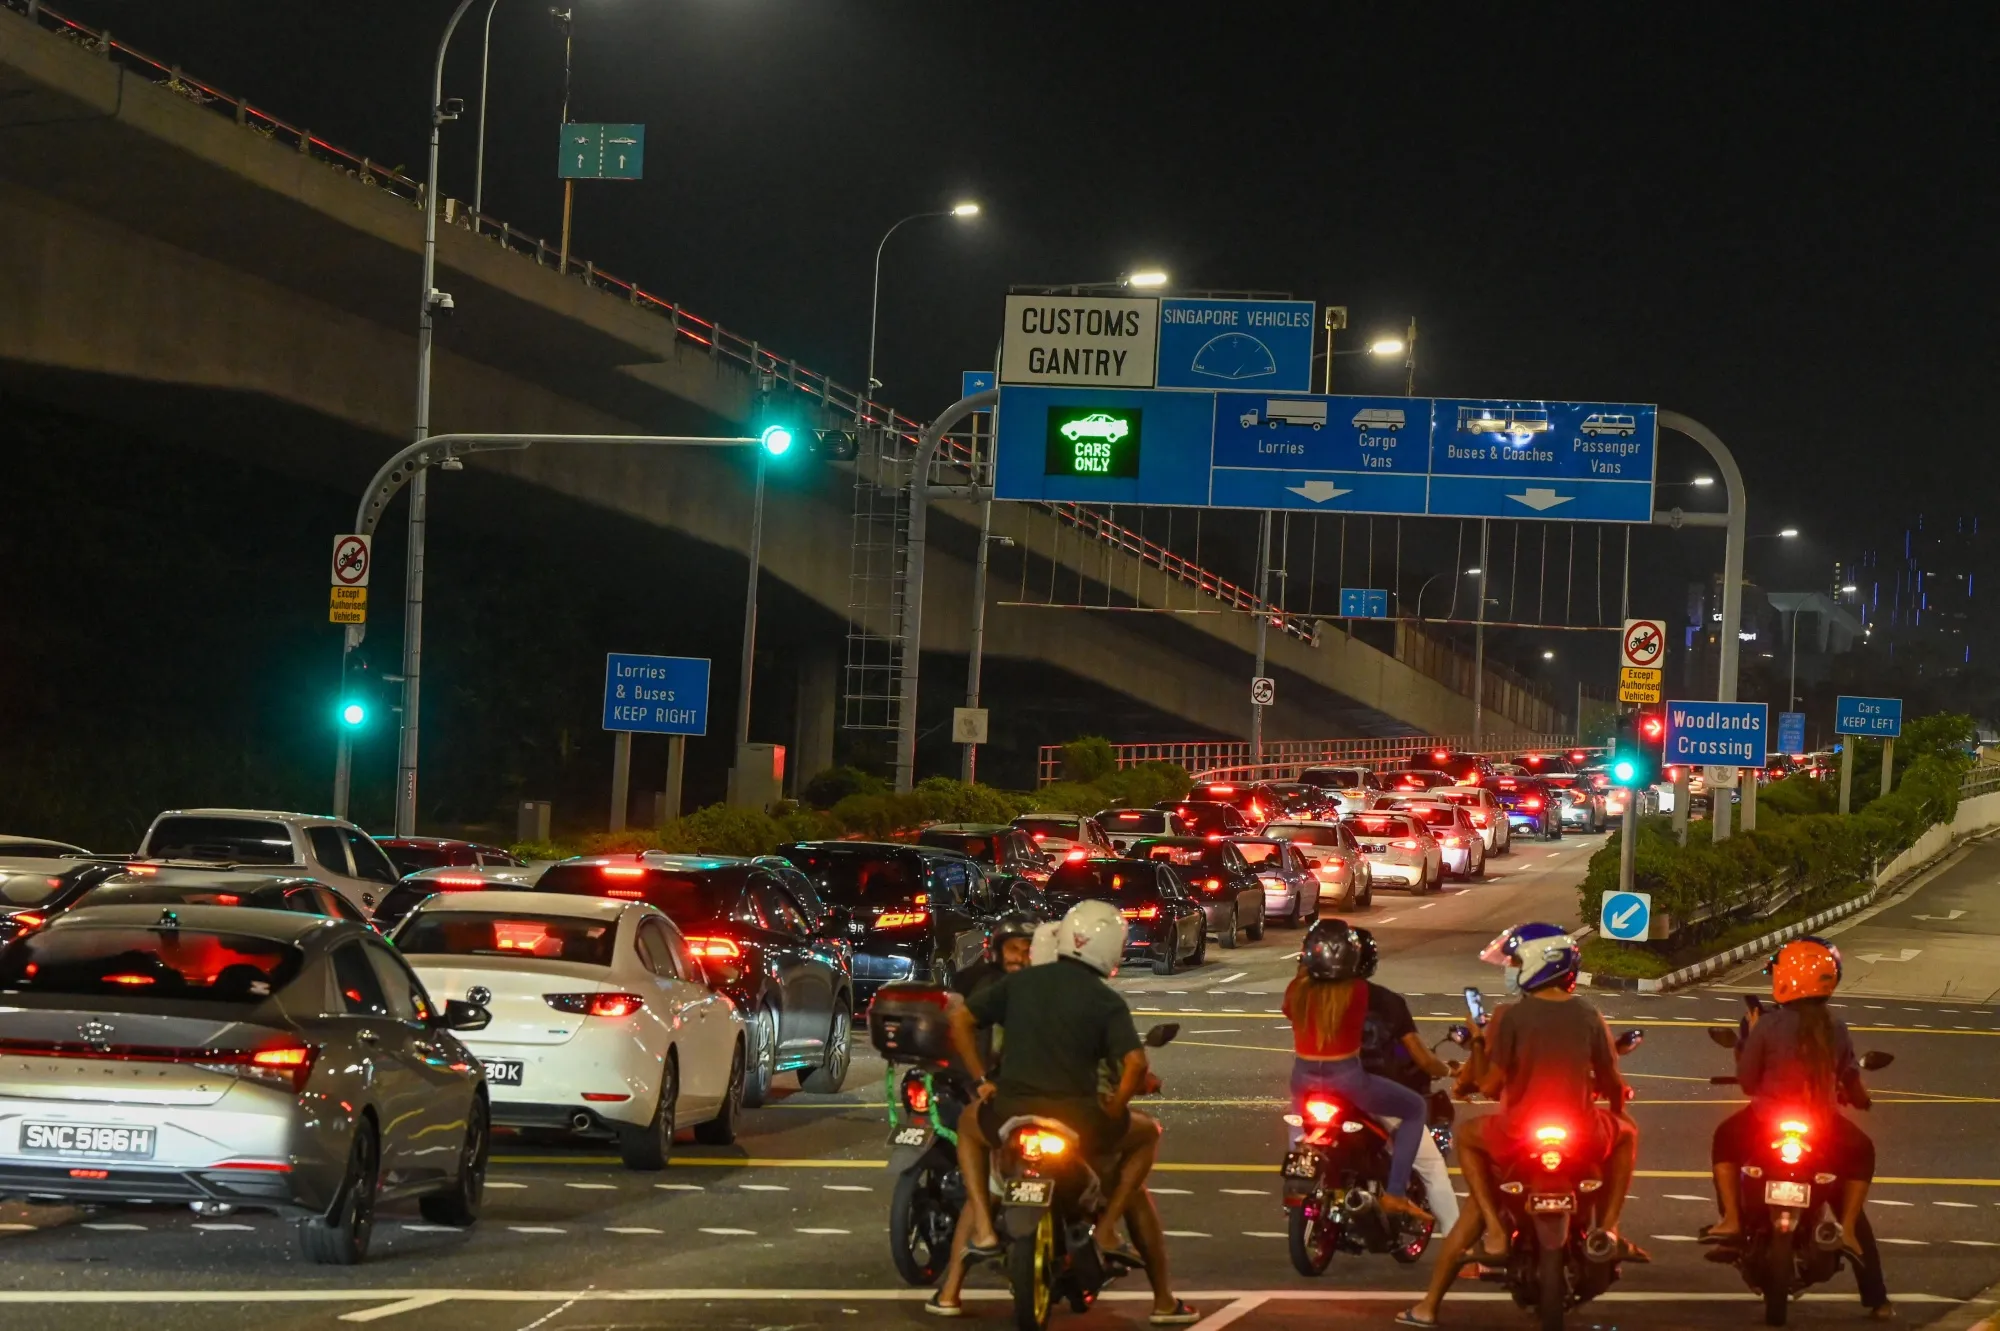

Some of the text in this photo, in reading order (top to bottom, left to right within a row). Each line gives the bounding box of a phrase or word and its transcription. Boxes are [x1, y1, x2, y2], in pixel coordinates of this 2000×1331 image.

[1022, 307, 1139, 337] CUSTOMS
[1164, 309, 1310, 327] SINGAPORE VEHICLES
[1029, 347, 1128, 377] GANTRY
[1258, 440, 1305, 455] Lorries
[1359, 433, 1397, 450] Cargo
[1573, 438, 1641, 456] Passenger
[1075, 442, 1111, 457] CARS
[1448, 444, 1554, 462] Buses & Coaches
[1075, 457, 1111, 472] ONLY
[1362, 454, 1392, 468] Vans
[1590, 459, 1621, 475] Vans
[337, 588, 360, 600] Except
[330, 599, 366, 610] Authorised
[333, 611, 361, 621] Vehicles
[616, 662, 666, 679] Lorries
[1628, 669, 1654, 681] Except
[615, 683, 675, 702] & Buses
[1620, 680, 1660, 691] Authorised
[1624, 691, 1655, 701] Vehicles
[613, 705, 697, 724] KEEP RIGHT
[1858, 702, 1881, 714] Cars
[1673, 709, 1760, 731] Woodlands
[1842, 716, 1894, 730] KEEP LEFT
[1678, 736, 1753, 760] Crossing
[848, 923, 864, 933] 9R
[26, 1124, 148, 1153] SNC5186H
